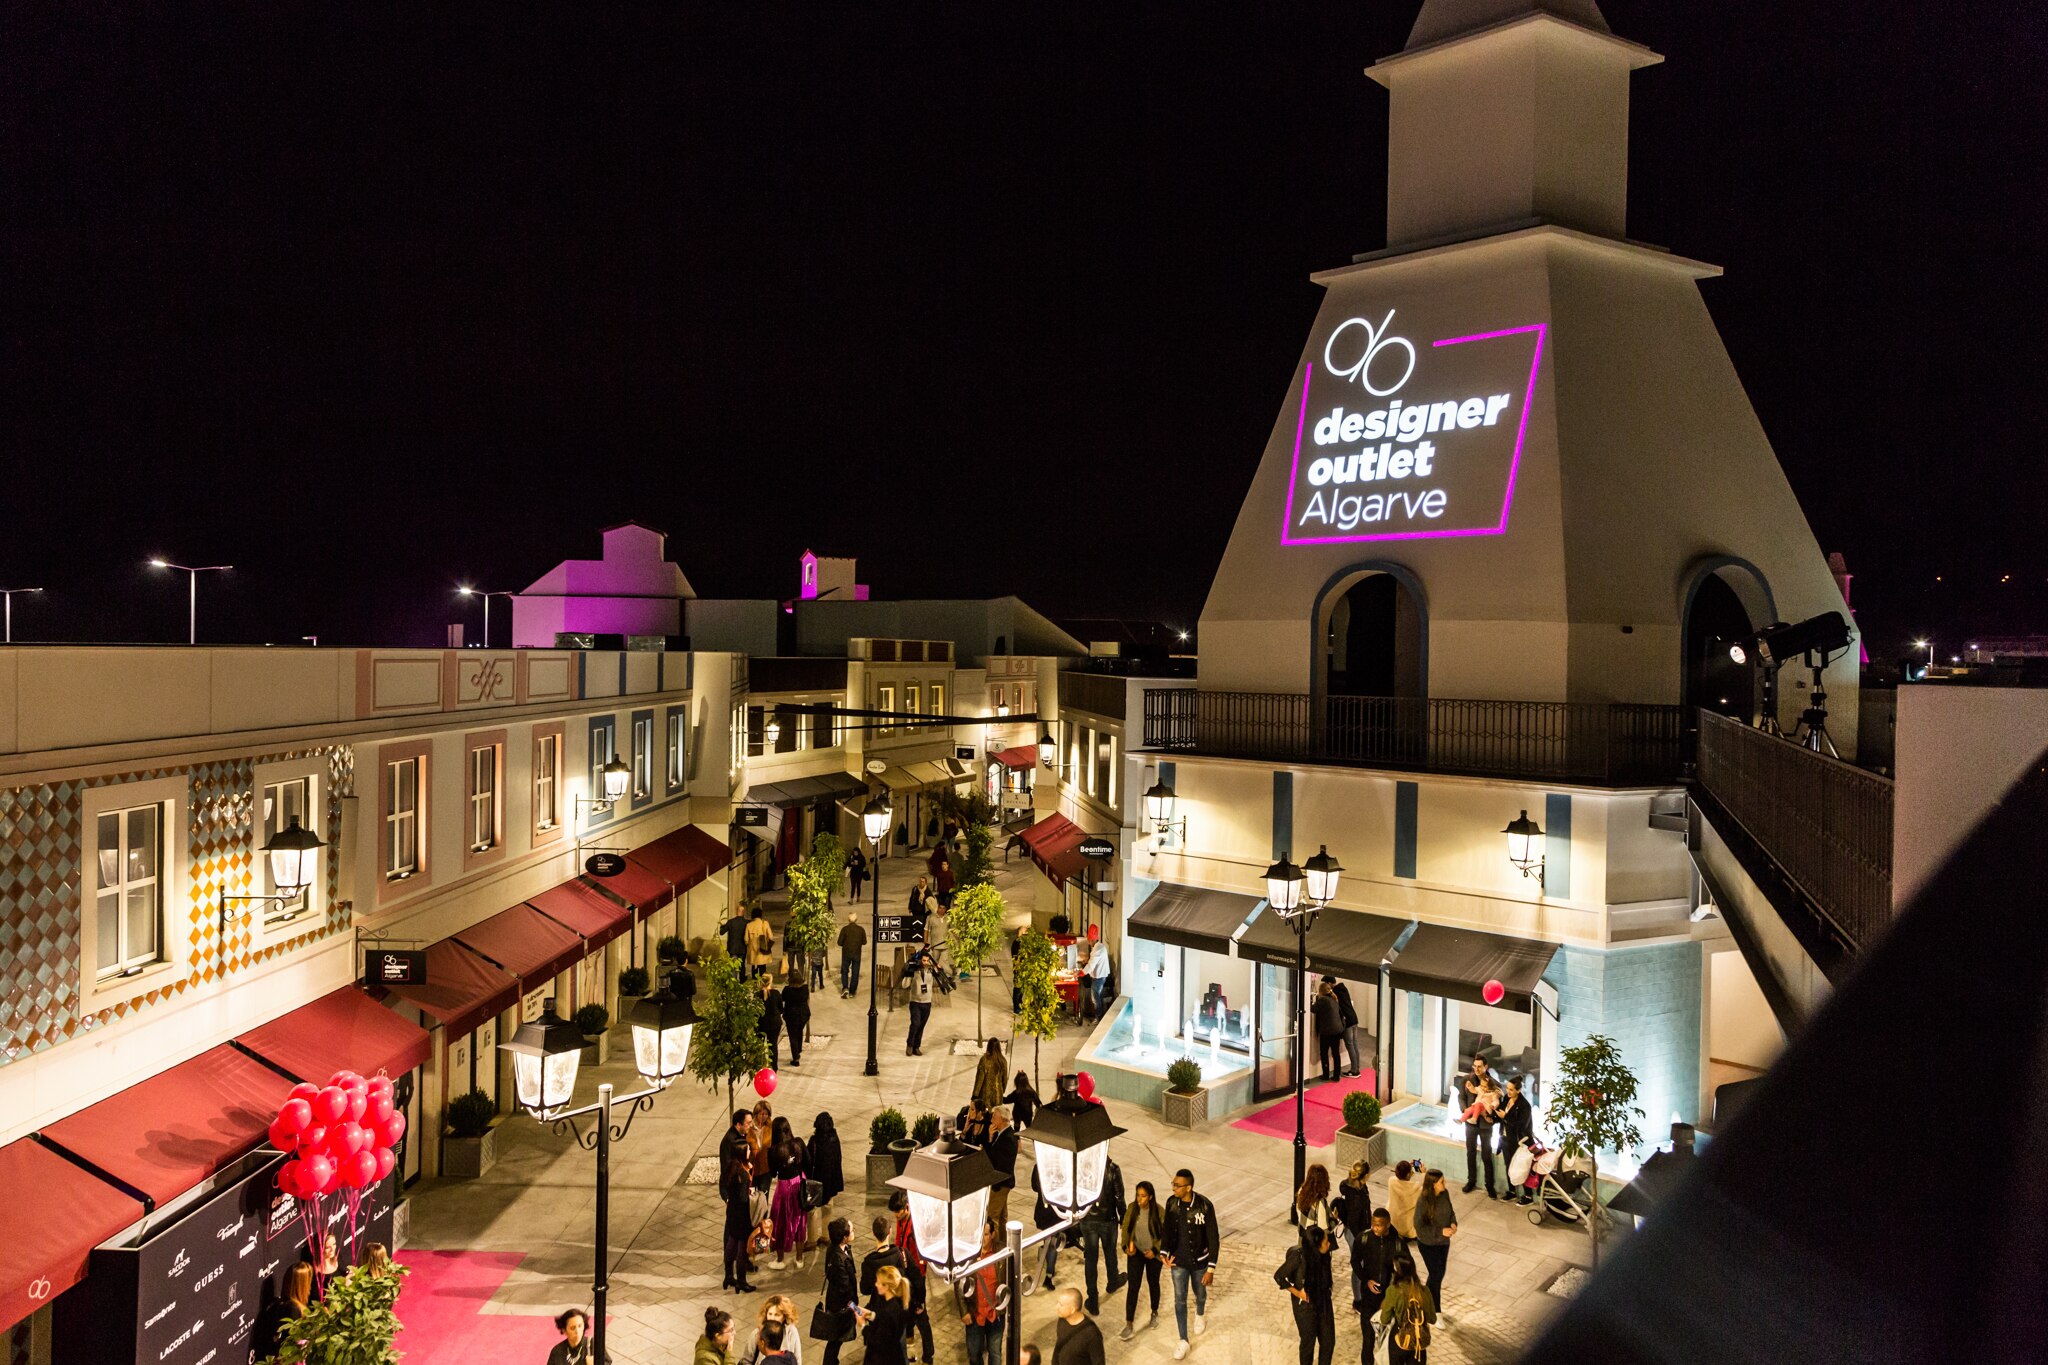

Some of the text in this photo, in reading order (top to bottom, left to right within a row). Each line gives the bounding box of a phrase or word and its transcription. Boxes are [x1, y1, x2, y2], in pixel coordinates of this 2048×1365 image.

[1313, 393, 1511, 446] designer
[1307, 441, 1436, 486] outlet
[1299, 488, 1447, 530] Algarve
[1080, 845, 1113, 853] Beontime
[194, 1264, 224, 1293] GUESS
[144, 1301, 177, 1329] Samsonite
[159, 1329, 191, 1361] LACOSTE
